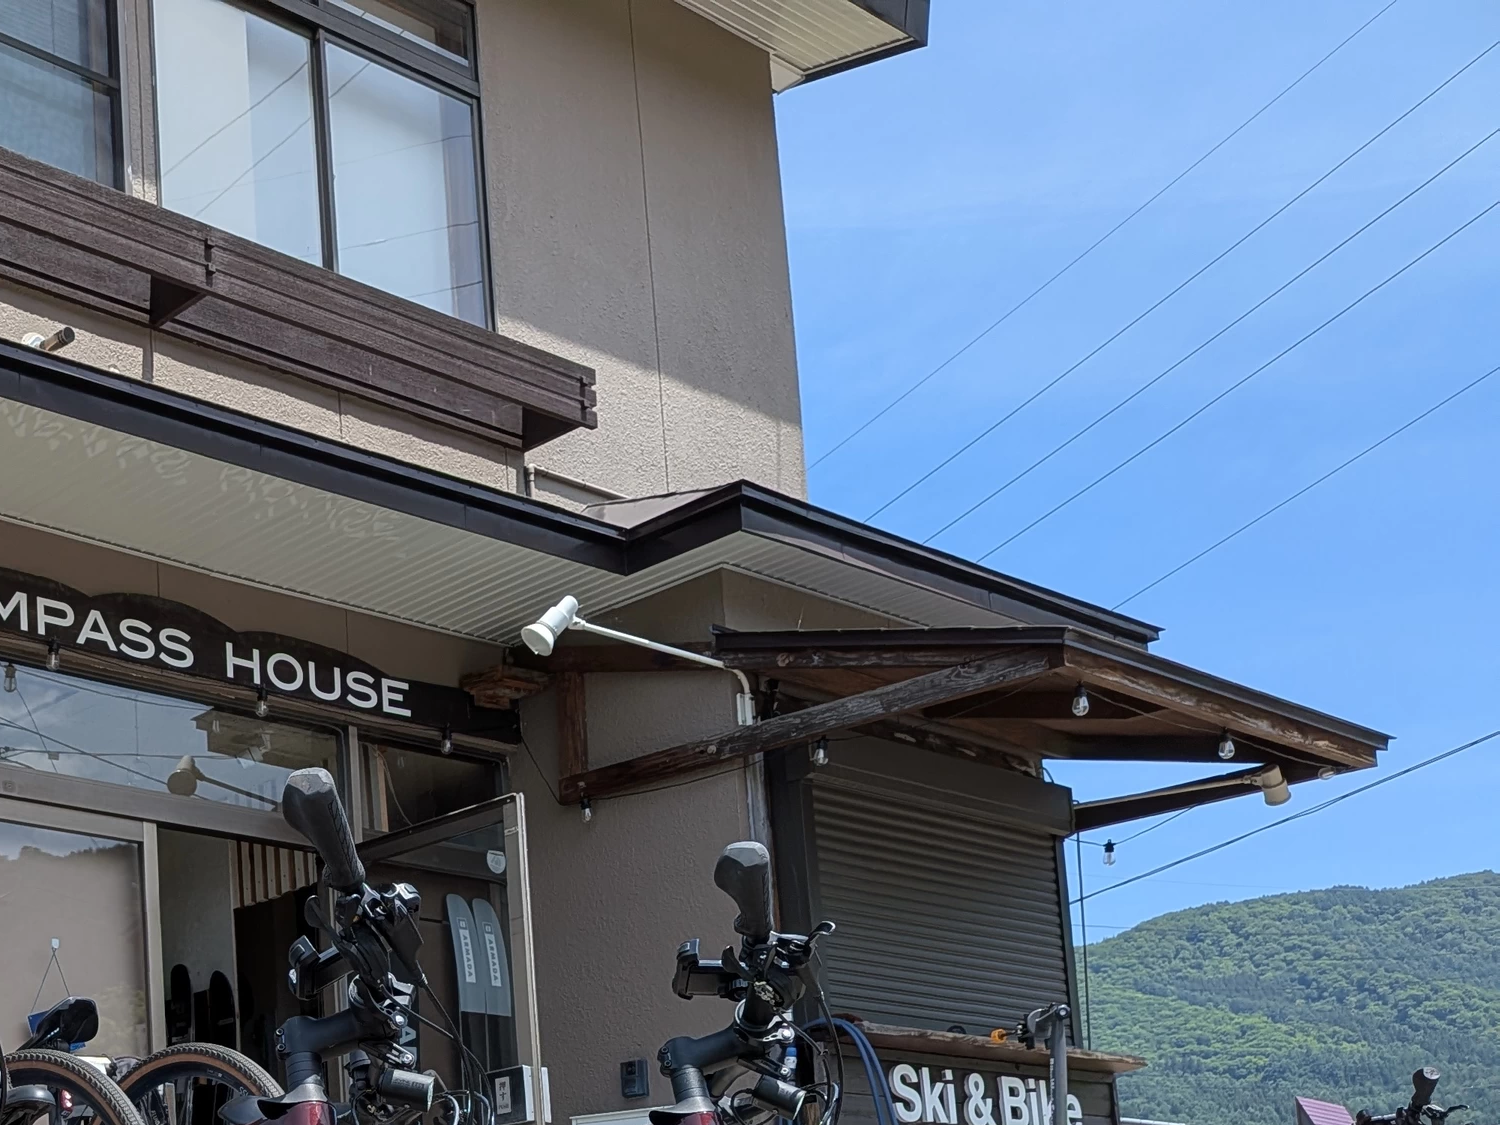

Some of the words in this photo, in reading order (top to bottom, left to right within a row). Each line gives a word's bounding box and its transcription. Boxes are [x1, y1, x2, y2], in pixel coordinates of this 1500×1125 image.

[226, 641, 412, 717] HOUSE
[462, 935, 473, 977] ARMADA
[487, 939, 499, 982] ARMADA
[888, 1063, 958, 1125] Ski
